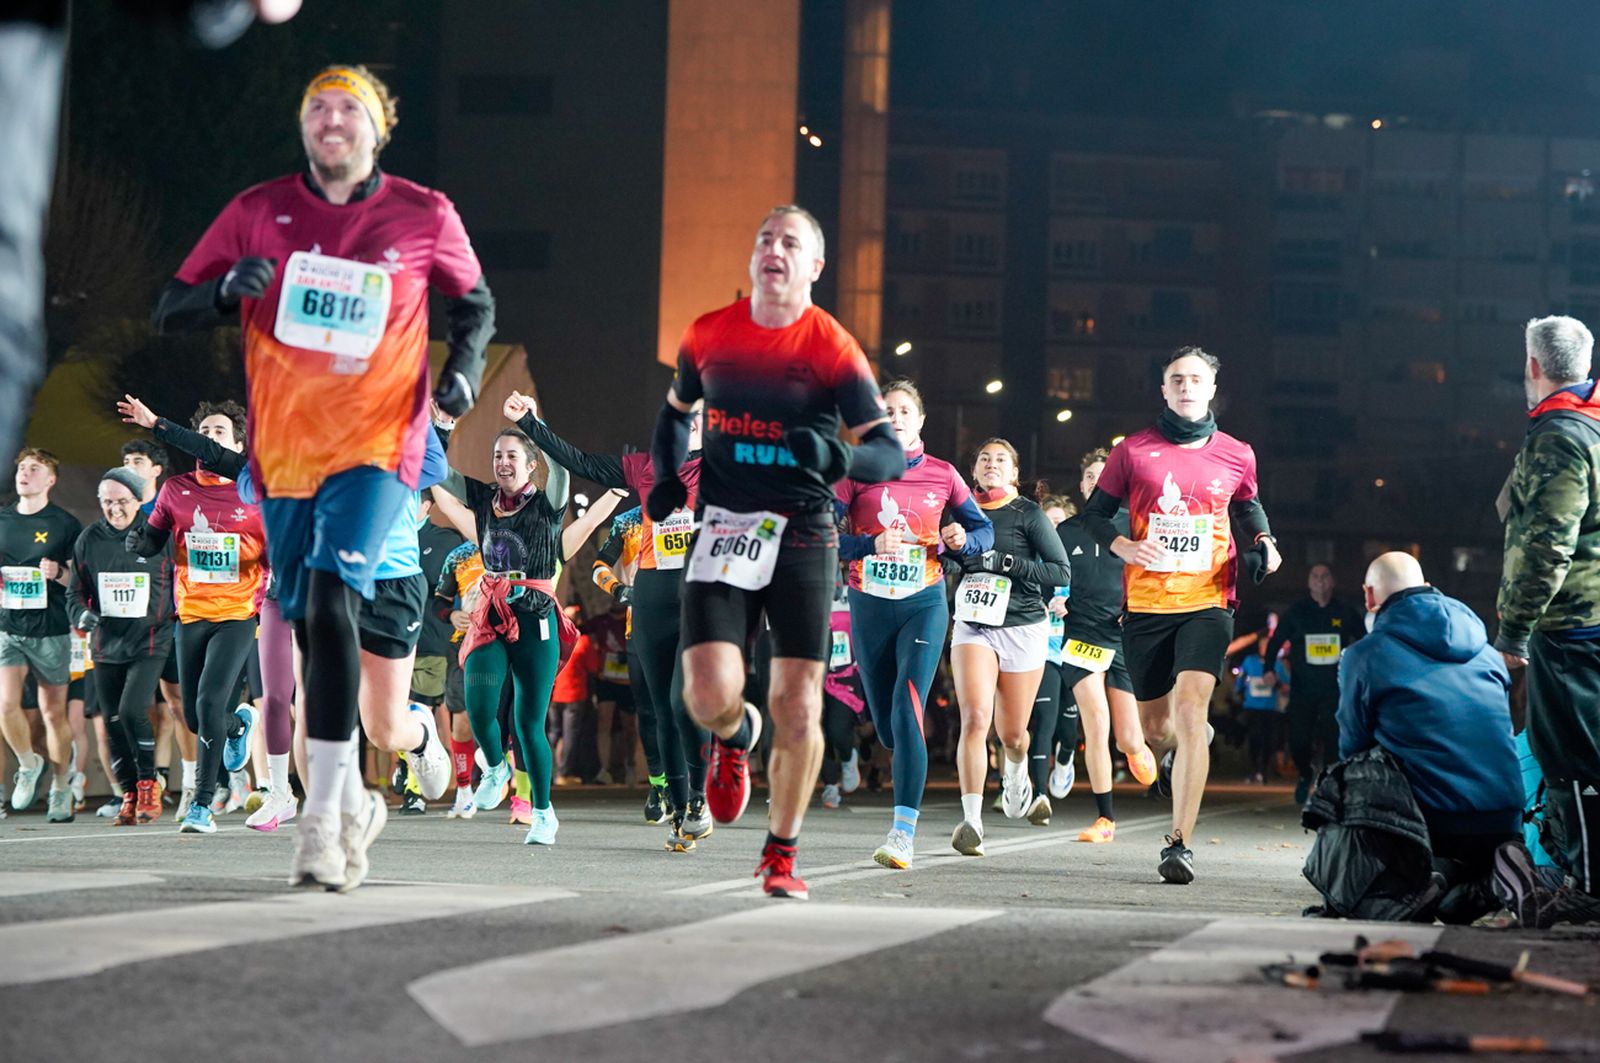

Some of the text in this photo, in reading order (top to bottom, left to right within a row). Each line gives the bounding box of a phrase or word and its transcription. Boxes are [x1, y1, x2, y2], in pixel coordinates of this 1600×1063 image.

[302, 289, 366, 322] 6810
[707, 407, 783, 440] Pieles
[710, 533, 762, 562] 6060
[195, 551, 230, 566] 12131
[871, 562, 918, 583] 13382
[9, 582, 39, 595] 13281
[112, 589, 136, 602] 1117
[964, 589, 998, 607] 5347
[1075, 643, 1103, 659] 4713
